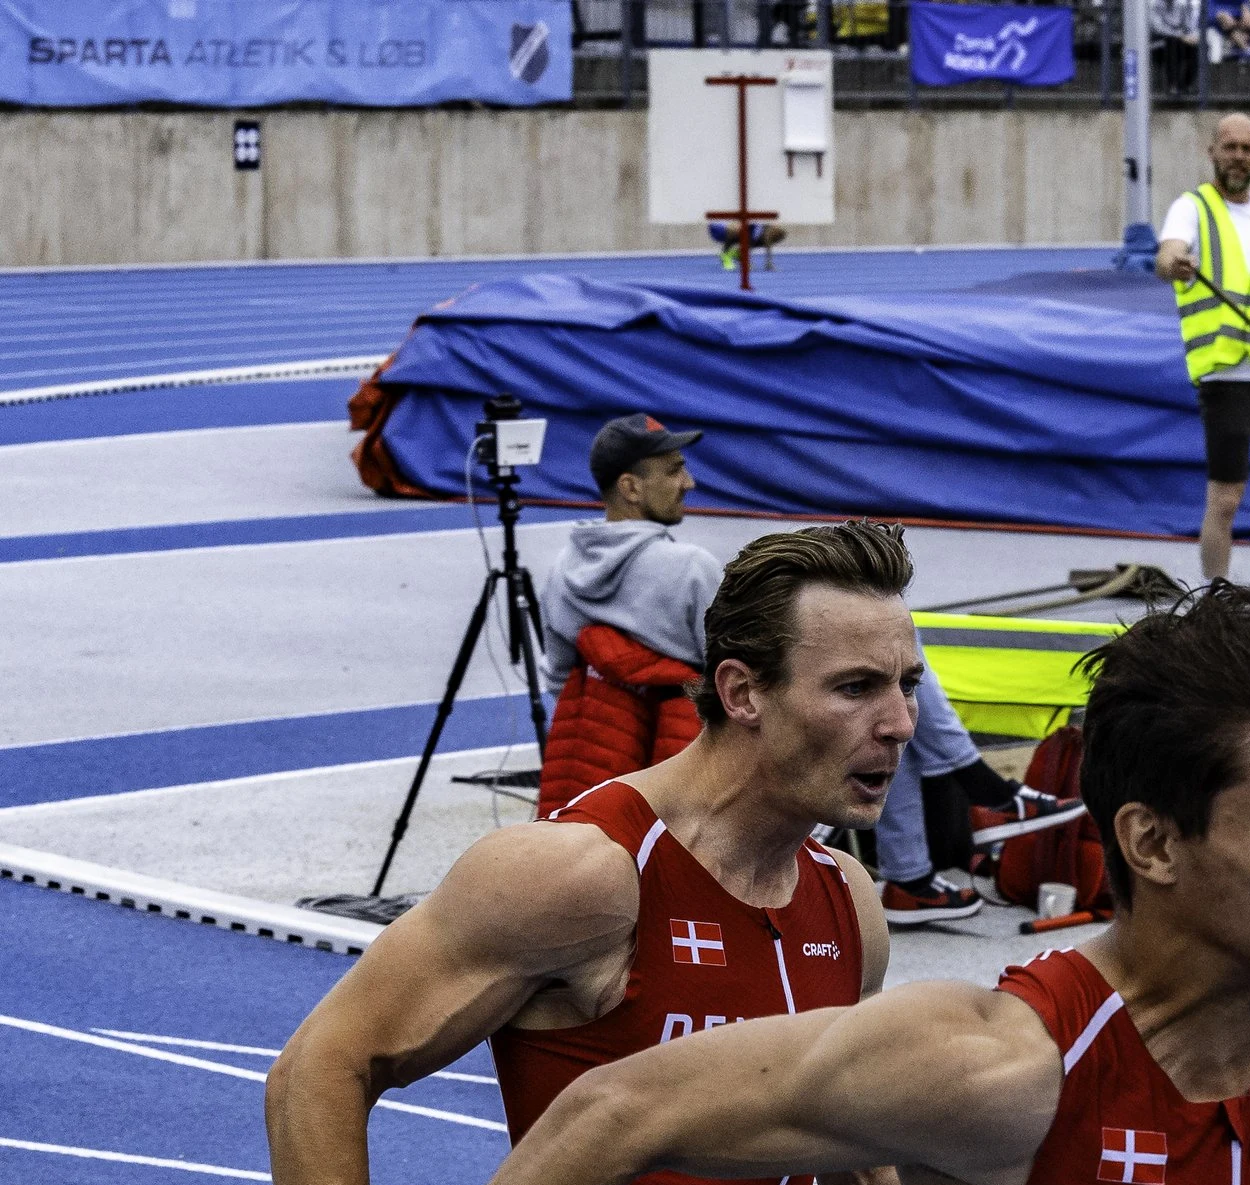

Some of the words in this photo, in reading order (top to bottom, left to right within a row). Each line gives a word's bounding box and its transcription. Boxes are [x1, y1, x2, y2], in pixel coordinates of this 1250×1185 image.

[27, 36, 172, 66] SPARTA
[184, 38, 315, 67] ATLETIK
[325, 38, 348, 67] &
[357, 39, 429, 68] LØB
[802, 942, 831, 957] CRAFT
